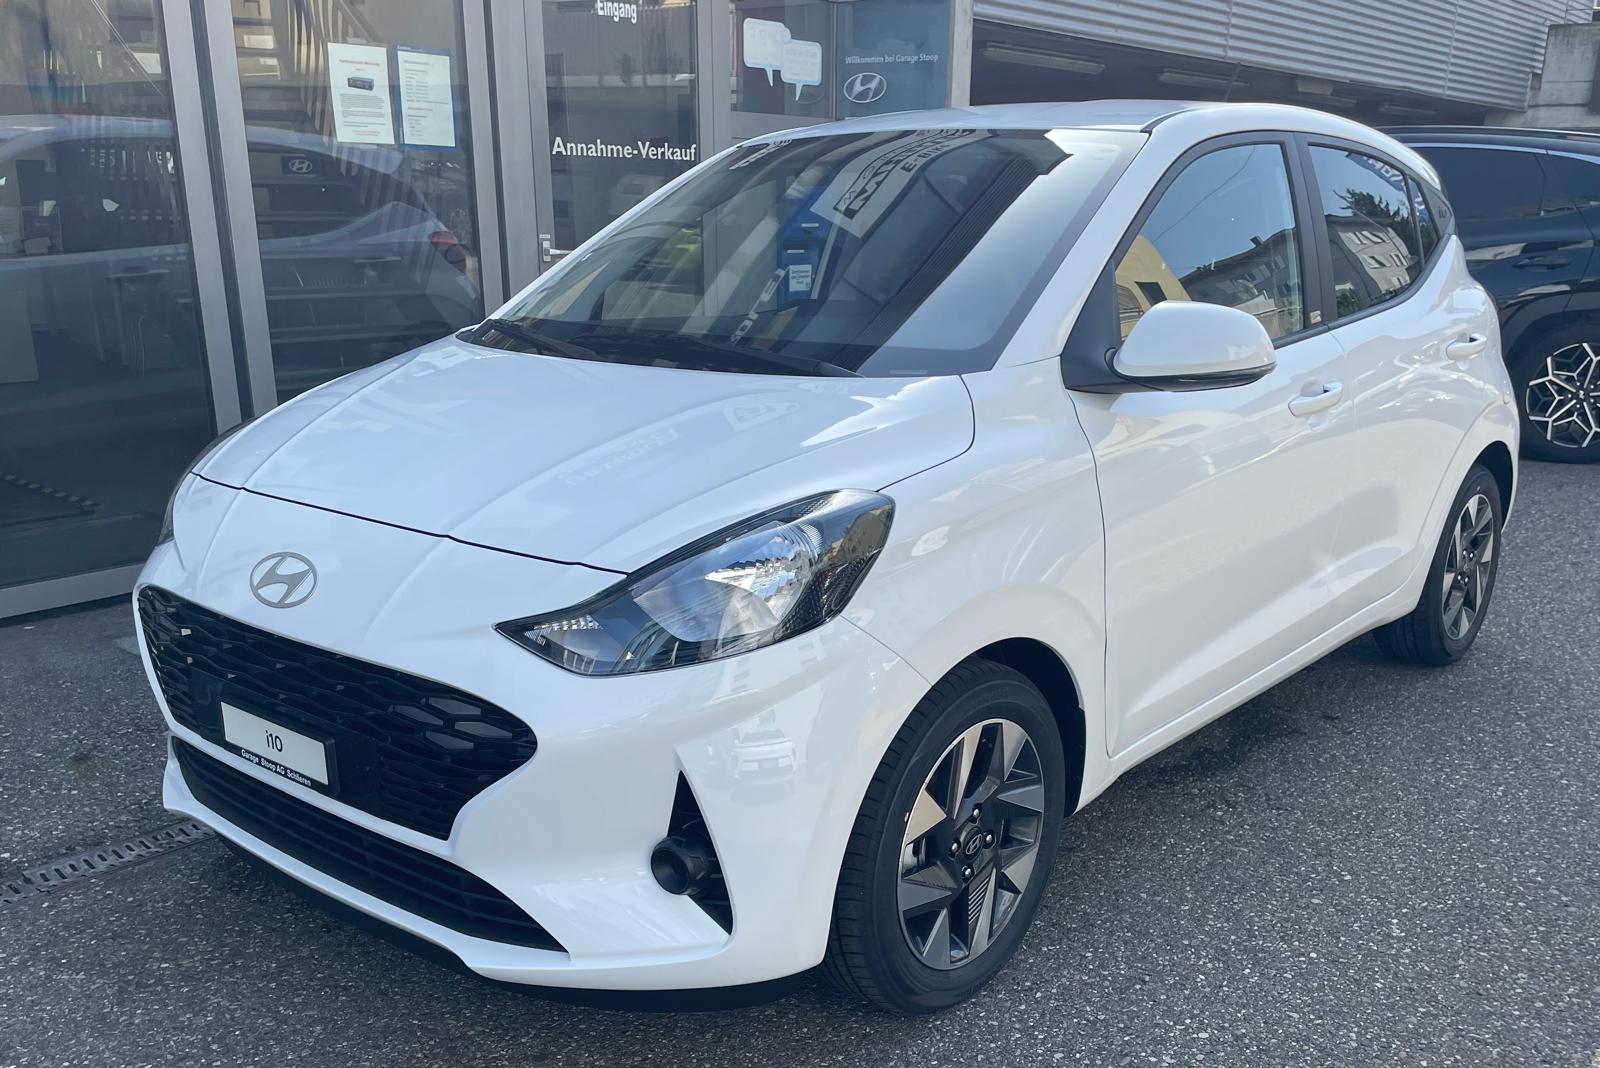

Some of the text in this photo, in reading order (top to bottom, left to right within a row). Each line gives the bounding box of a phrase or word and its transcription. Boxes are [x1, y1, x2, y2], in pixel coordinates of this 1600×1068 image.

[597, 0, 637, 23] Eingang
[845, 53, 938, 64] Willkommen bei Garage Stoop
[552, 137, 696, 161] Annahme-Verkauf
[265, 729, 283, 752] i10
[241, 749, 259, 763] Garage
[261, 757, 276, 771] Stoop
[276, 764, 285, 775] AG
